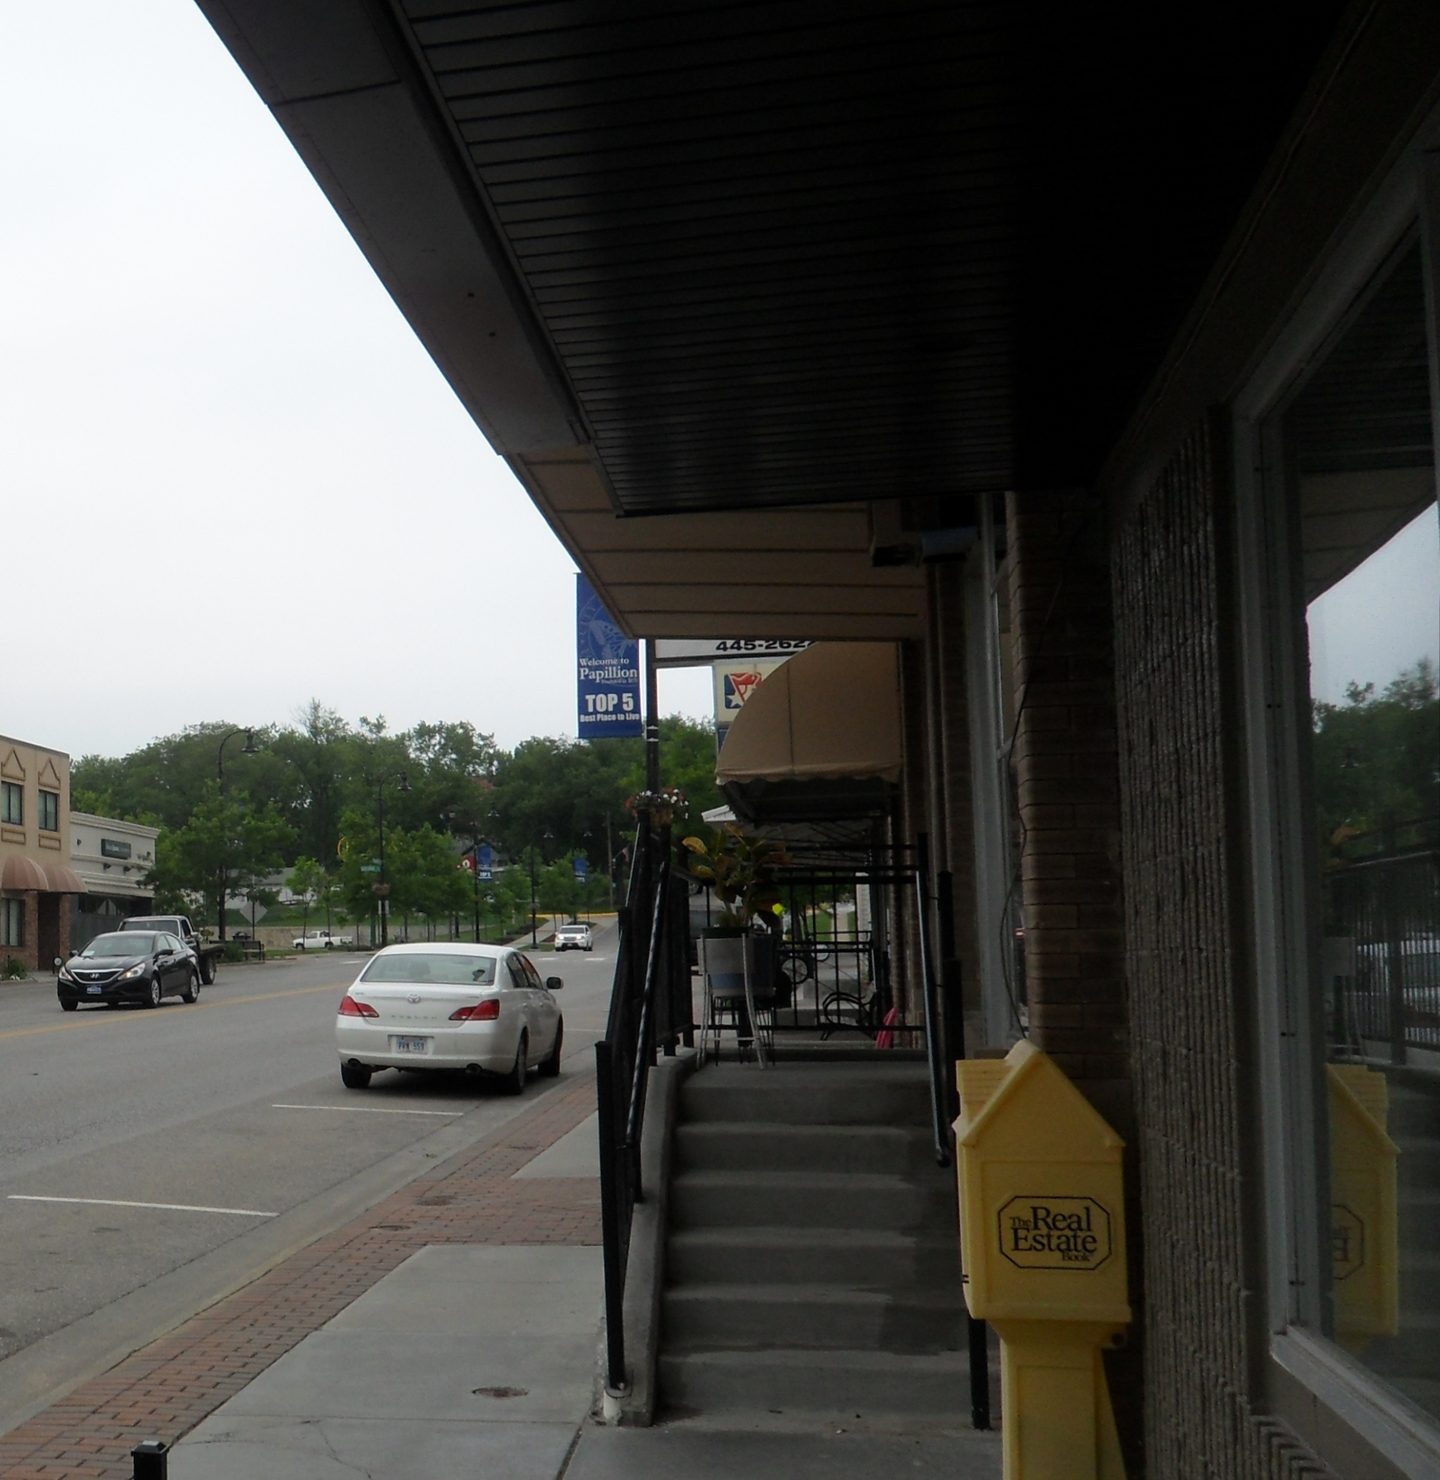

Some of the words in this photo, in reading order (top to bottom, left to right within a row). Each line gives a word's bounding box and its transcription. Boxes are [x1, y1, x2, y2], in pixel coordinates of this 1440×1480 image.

[579, 657, 618, 667] Welcome
[620, 657, 630, 665] to
[579, 666, 638, 682] Papillion
[585, 693, 617, 712] TOP
[622, 692, 634, 712] 5
[579, 714, 596, 723] Best
[597, 713, 617, 722] Place
[618, 713, 625, 721] to
[625, 712, 640, 721] Live
[1009, 1216, 1031, 1227] The
[1030, 1205, 1092, 1232] Real
[1011, 1227, 1098, 1253] Estate
[1062, 1251, 1091, 1262] Book
